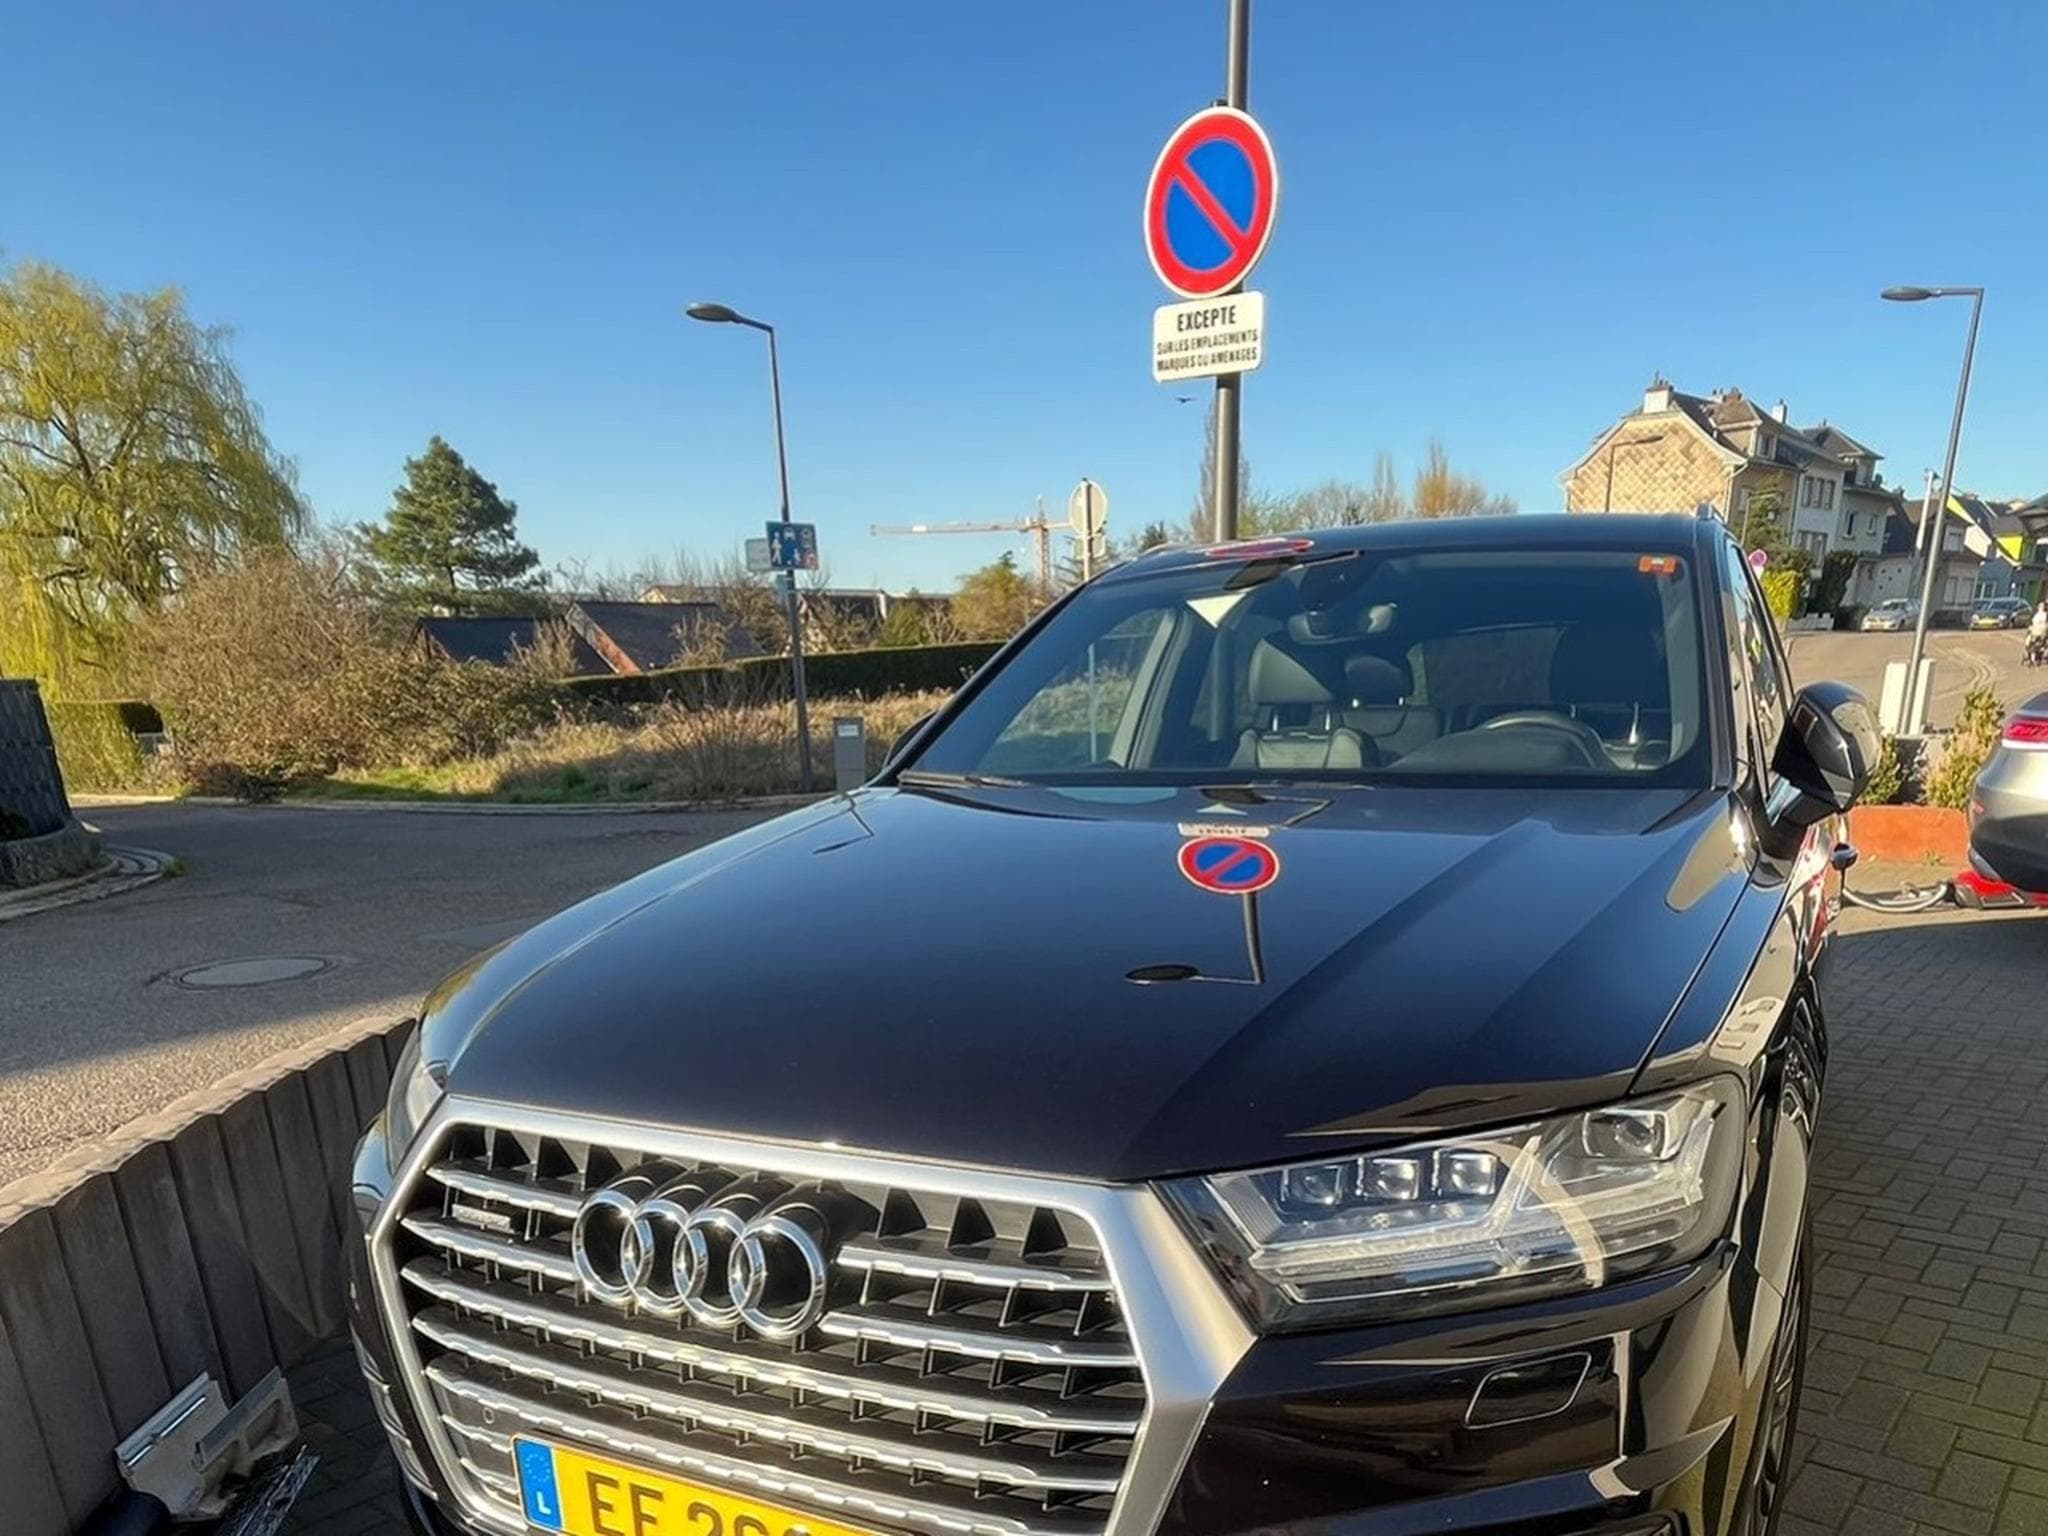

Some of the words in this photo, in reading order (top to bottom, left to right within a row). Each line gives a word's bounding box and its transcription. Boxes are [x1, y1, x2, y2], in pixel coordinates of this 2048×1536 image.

[1177, 305, 1236, 332] EXCEPTE
[1174, 338, 1190, 352] LES
[1191, 329, 1258, 349] EMPLACEMENTS
[1157, 354, 1196, 371] MARQUES
[536, 1491, 552, 1515] L
